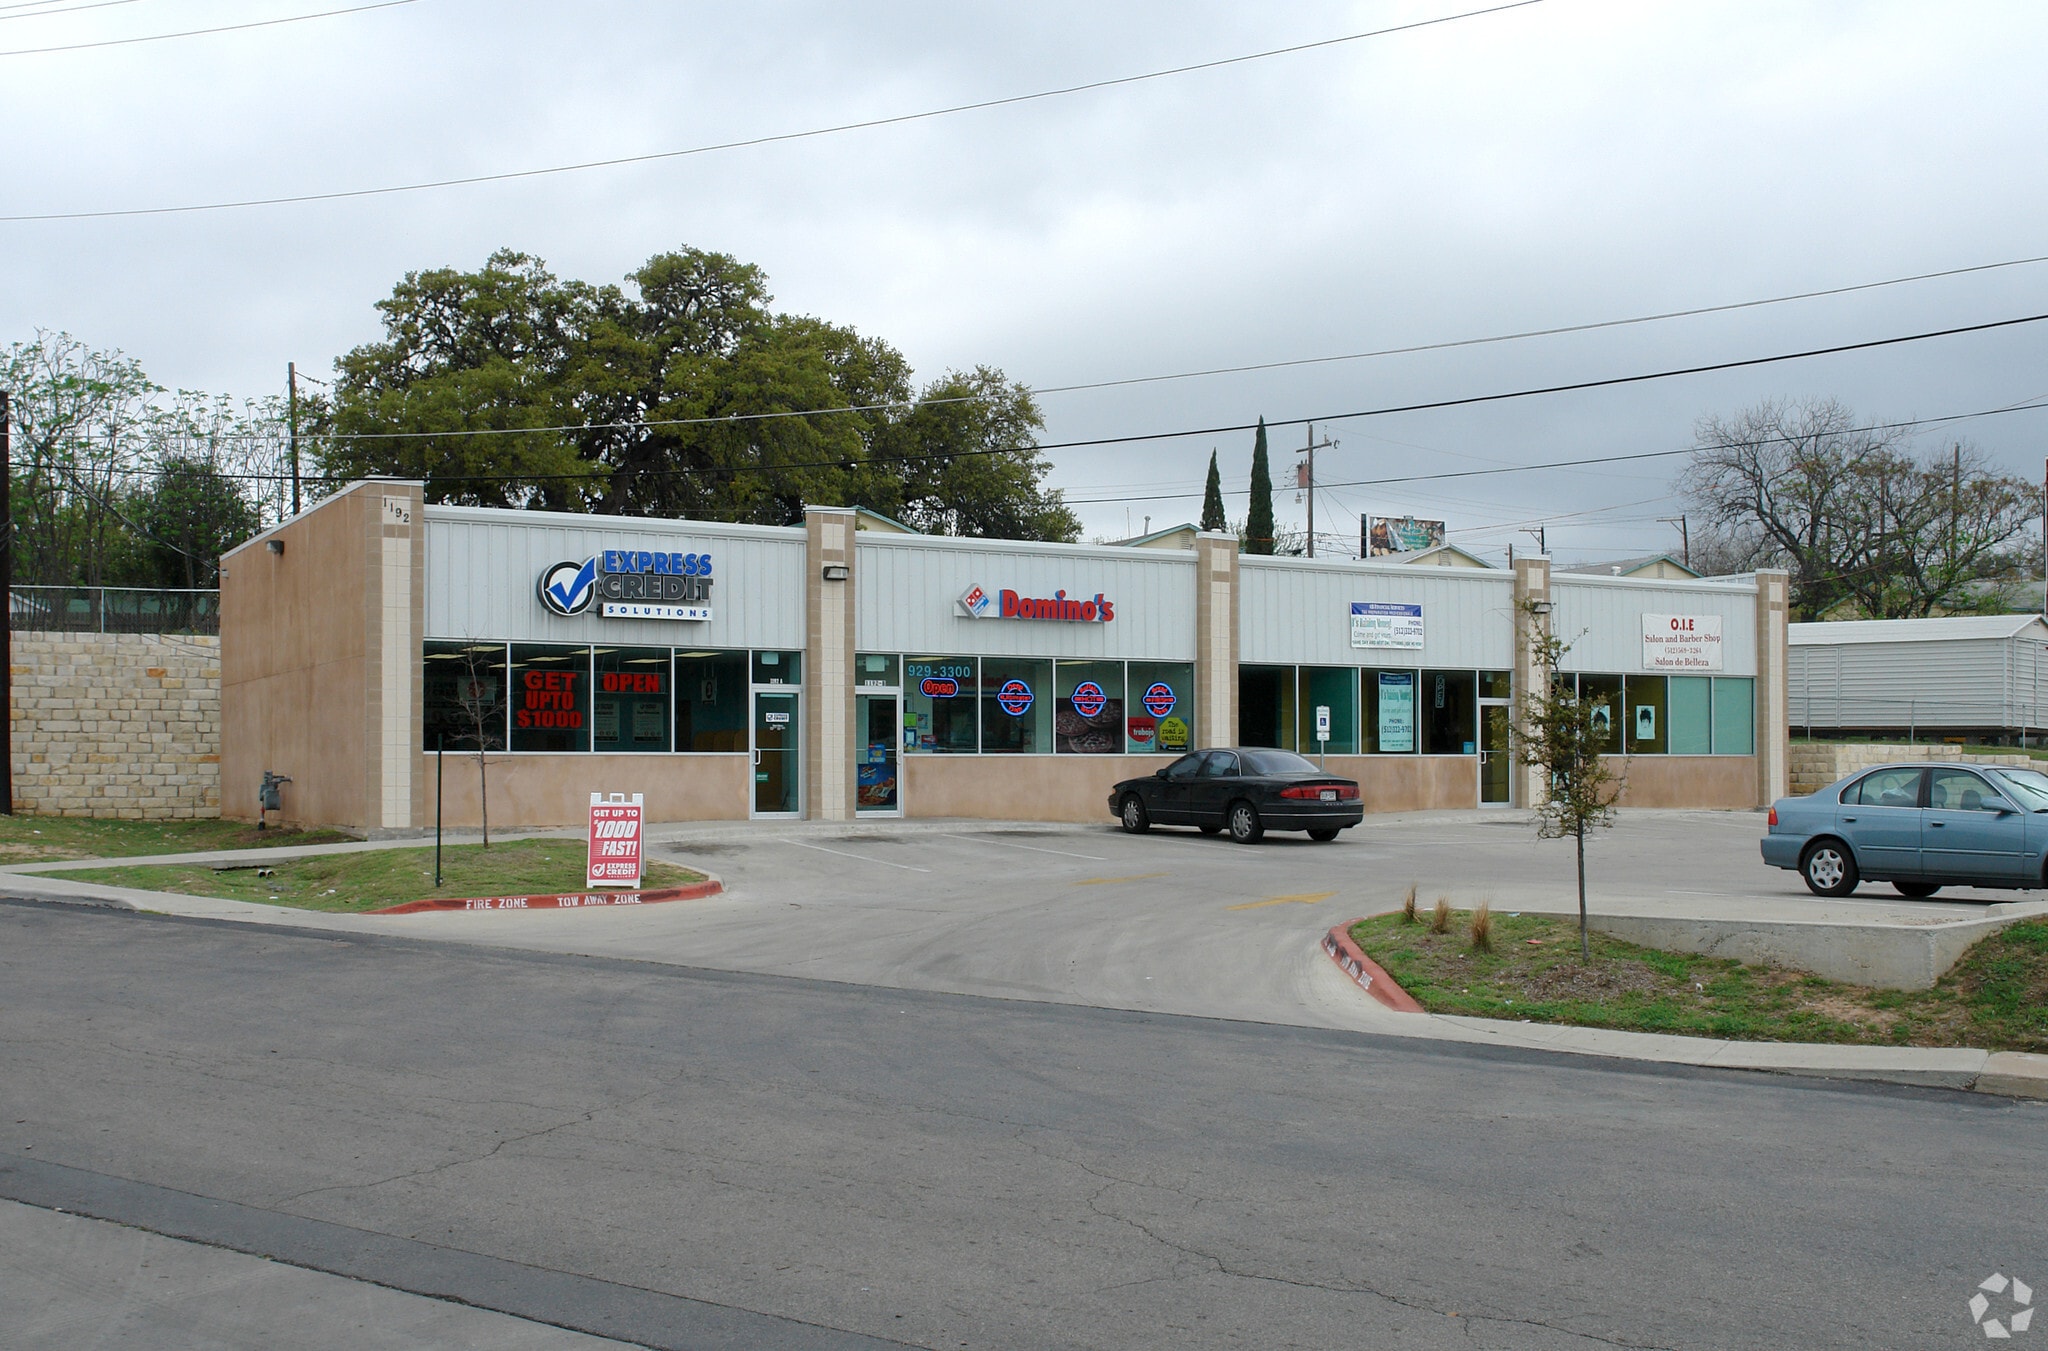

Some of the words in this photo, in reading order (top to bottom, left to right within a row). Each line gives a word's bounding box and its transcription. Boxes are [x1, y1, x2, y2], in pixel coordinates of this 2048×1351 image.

[383, 497, 410, 523] 1192
[604, 550, 712, 575] EXPRESS
[602, 574, 713, 600] CREDIT
[608, 606, 708, 617] SOLUTIONS
[1671, 618, 1694, 631] O.I.E
[1645, 634, 1663, 643] Salon
[1665, 635, 1677, 643] and
[1679, 634, 1702, 643] Barber
[1704, 633, 1720, 644] Shop
[1655, 656, 1673, 666] Salon
[1675, 657, 1683, 666] de
[1685, 657, 1709, 666] Belleza
[908, 665, 971, 678] 929-3300
[524, 670, 577, 690] GET
[603, 672, 659, 692] OPEN
[923, 680, 954, 696] Open
[517, 709, 582, 728] $1000
[1168, 720, 1178, 728] The
[1134, 727, 1155, 737] trabajo
[602, 841, 637, 856] FAST!
[466, 899, 492, 909] FIRE
[499, 898, 528, 909] ZONE
[557, 897, 579, 907] TOW
[584, 895, 608, 905] AWAY
[614, 894, 641, 905] ZONE
